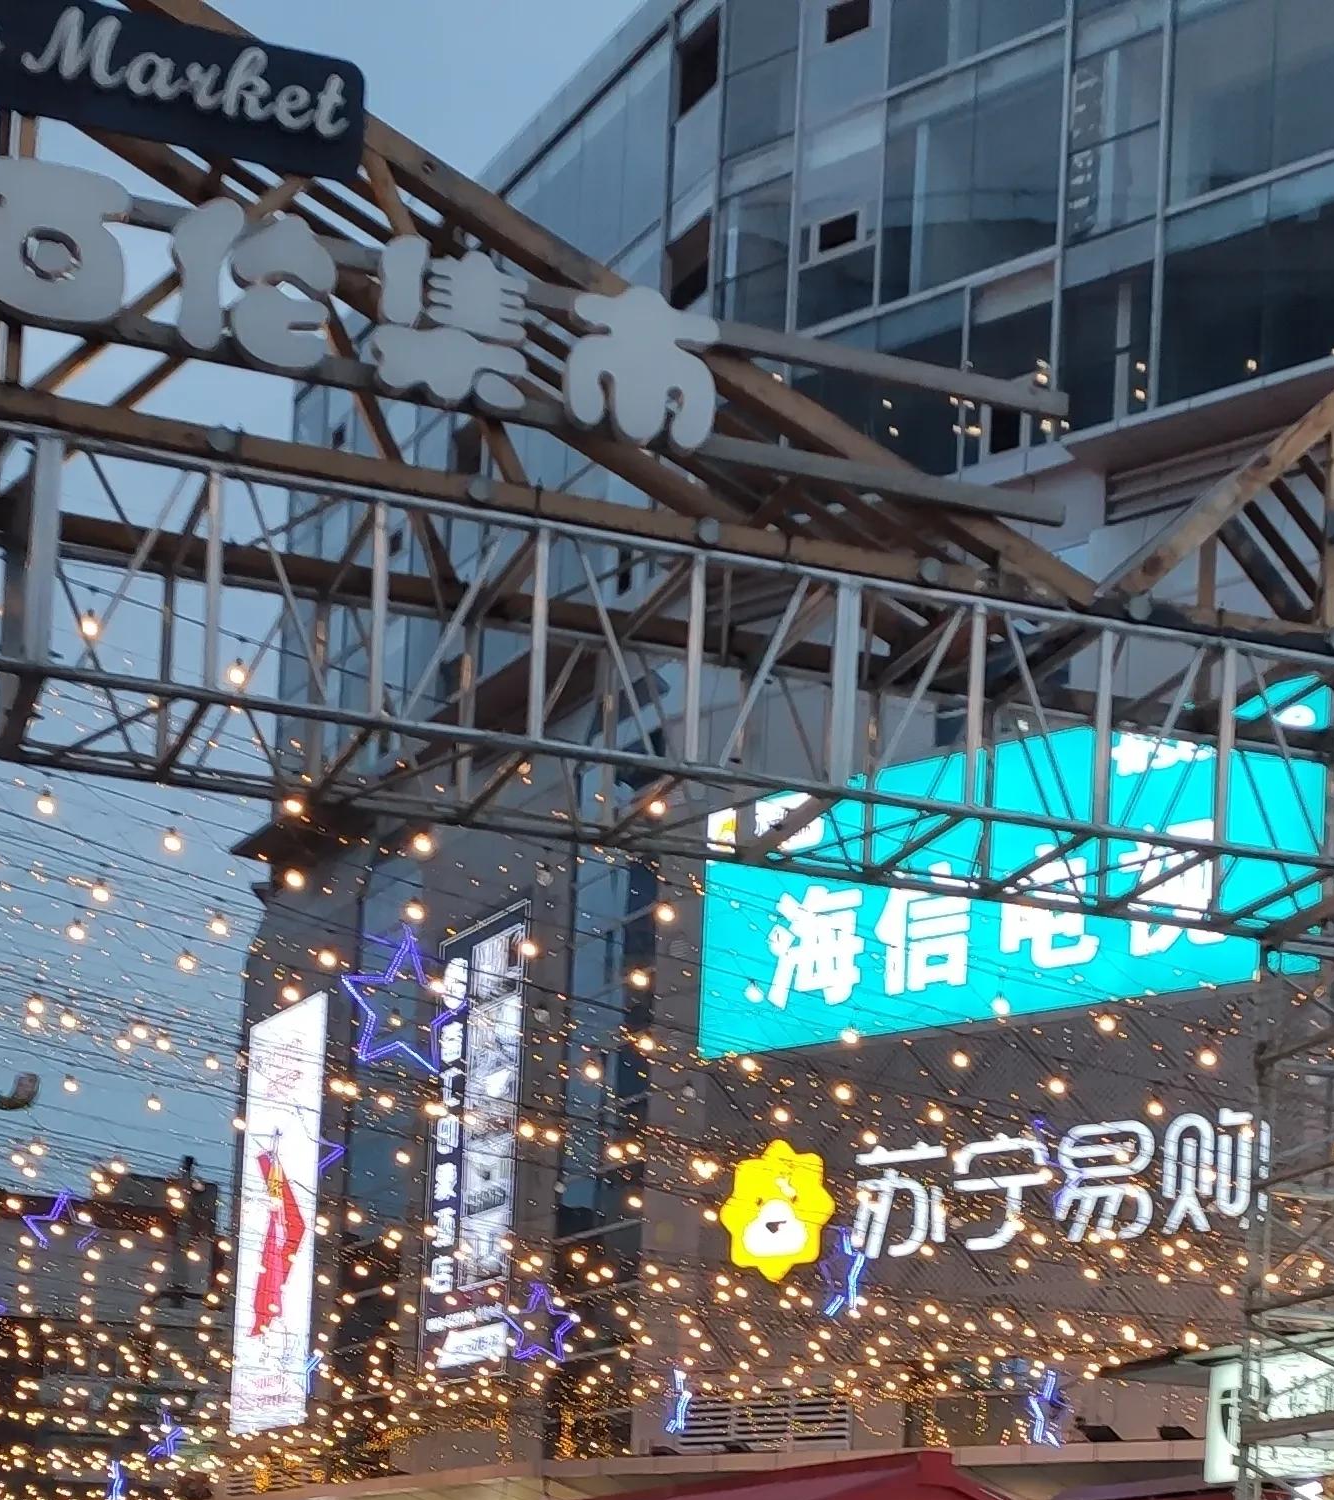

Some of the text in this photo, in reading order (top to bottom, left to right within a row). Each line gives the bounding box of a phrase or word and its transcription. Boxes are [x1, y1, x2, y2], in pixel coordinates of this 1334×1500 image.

[21, 5, 350, 140] Market
[851, 1108, 1272, 1260] 苏宁易购
